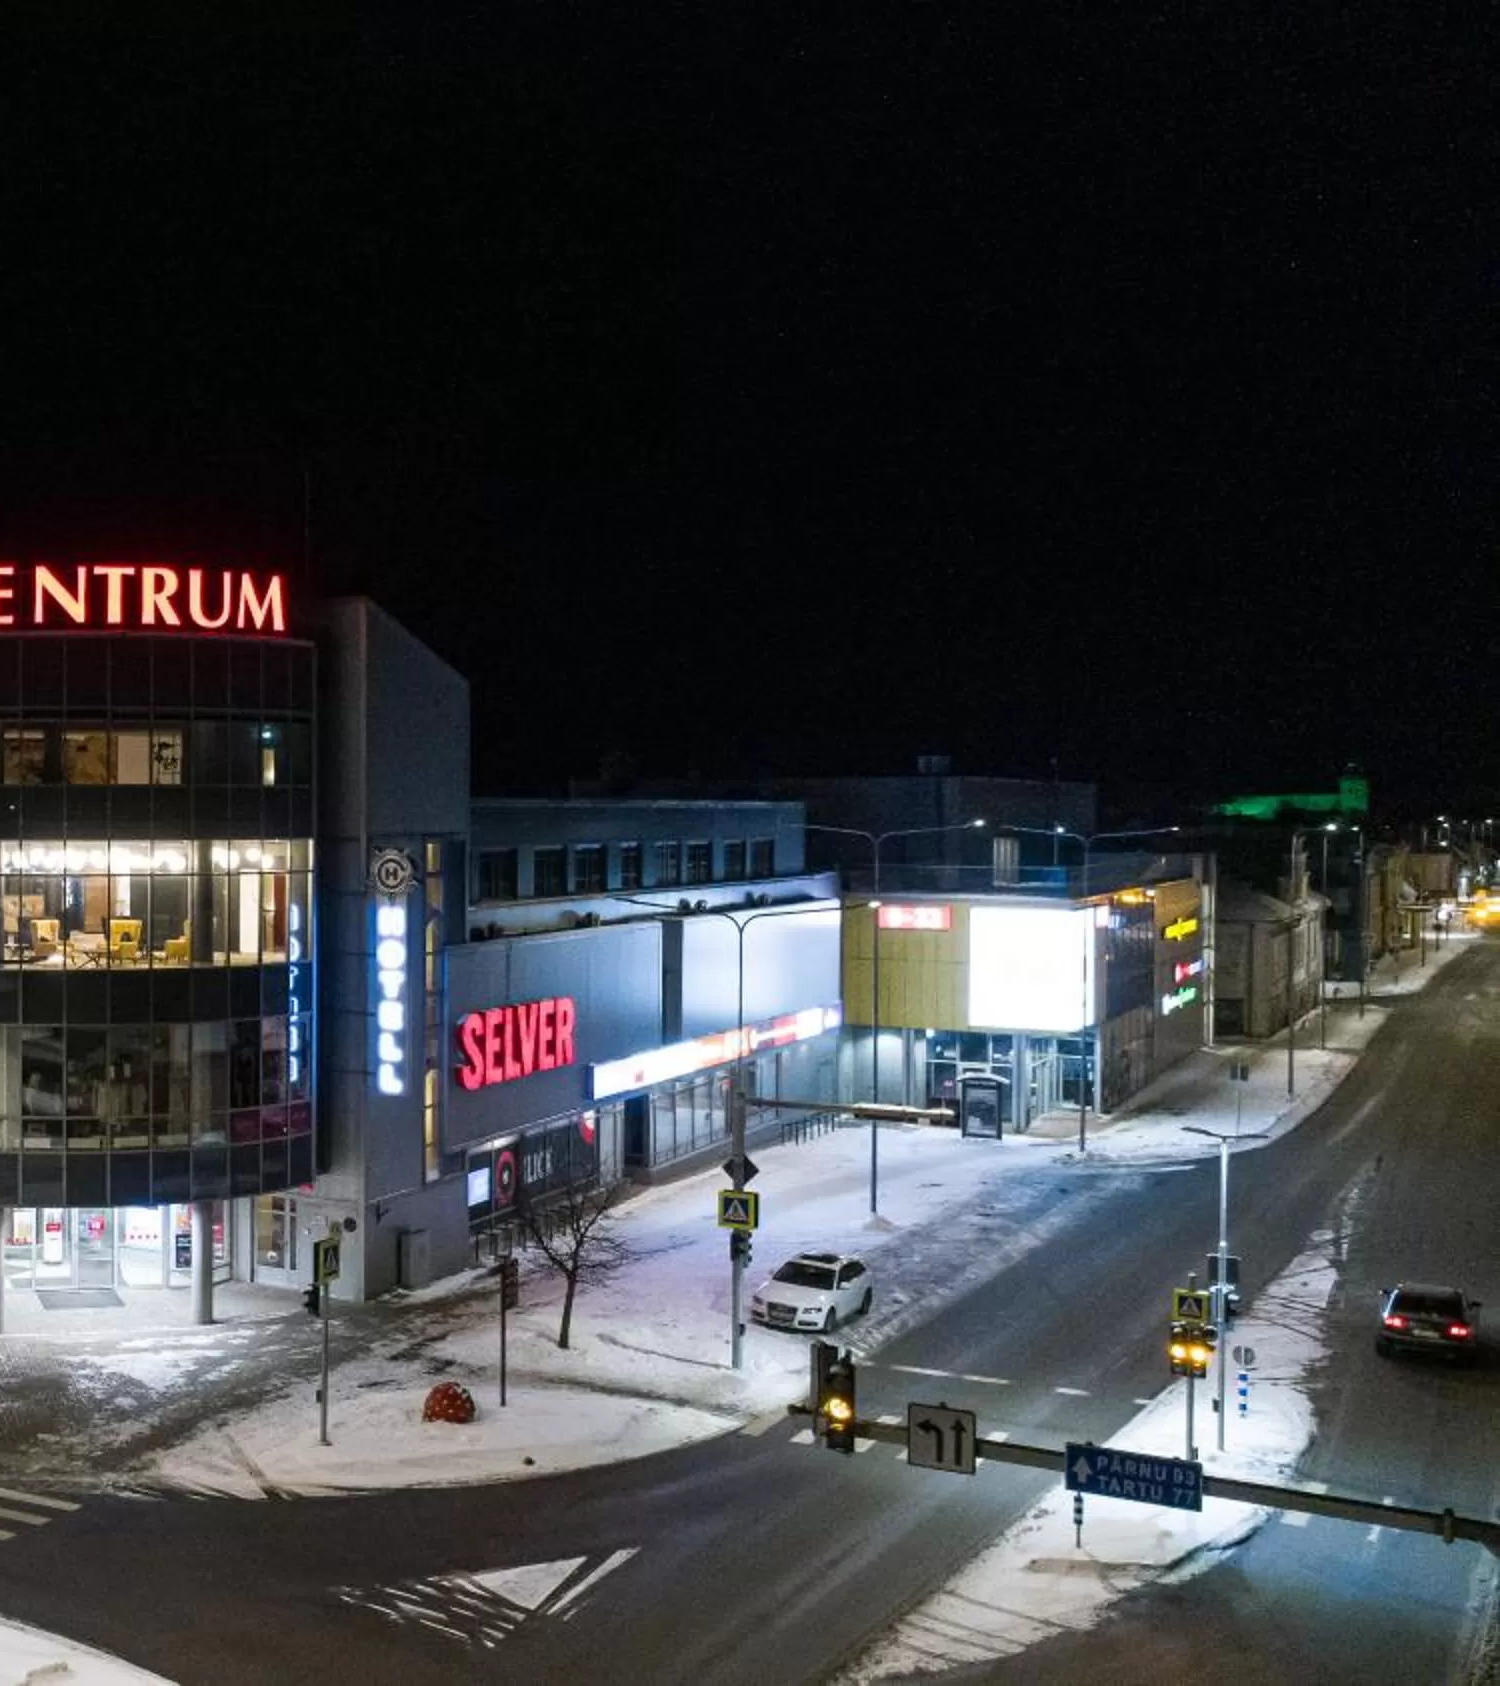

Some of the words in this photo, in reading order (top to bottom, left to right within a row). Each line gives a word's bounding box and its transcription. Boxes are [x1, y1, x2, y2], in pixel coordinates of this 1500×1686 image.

[377, 906, 405, 1094] HOTELL
[460, 997, 576, 1091] SELVER
[1096, 1475, 1164, 1501] TARTU
[1172, 1487, 1196, 1505] 77
